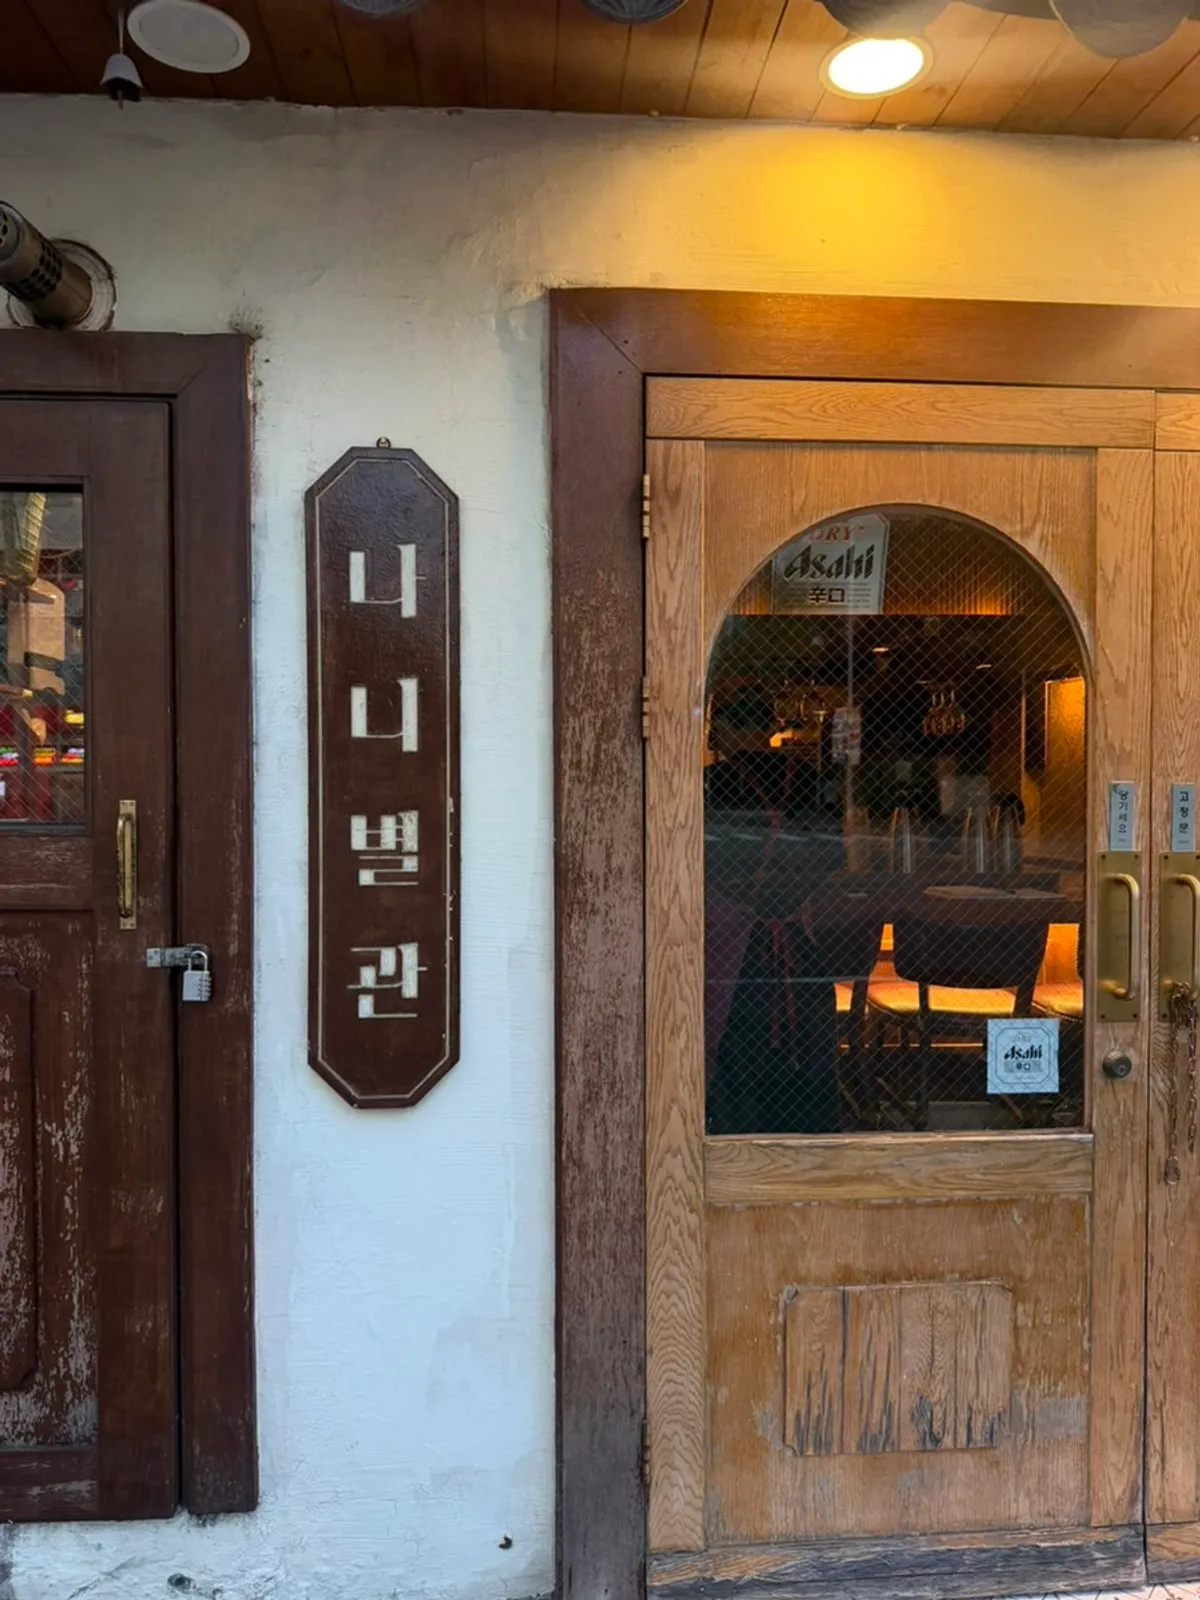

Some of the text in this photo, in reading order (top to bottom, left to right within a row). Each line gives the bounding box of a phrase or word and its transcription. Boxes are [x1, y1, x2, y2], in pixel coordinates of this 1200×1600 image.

[784, 544, 875, 579] Asahi
[808, 587, 845, 603] 辛口
[347, 543, 428, 1019] 나니별관
[1003, 1044, 1043, 1060] Asahi
